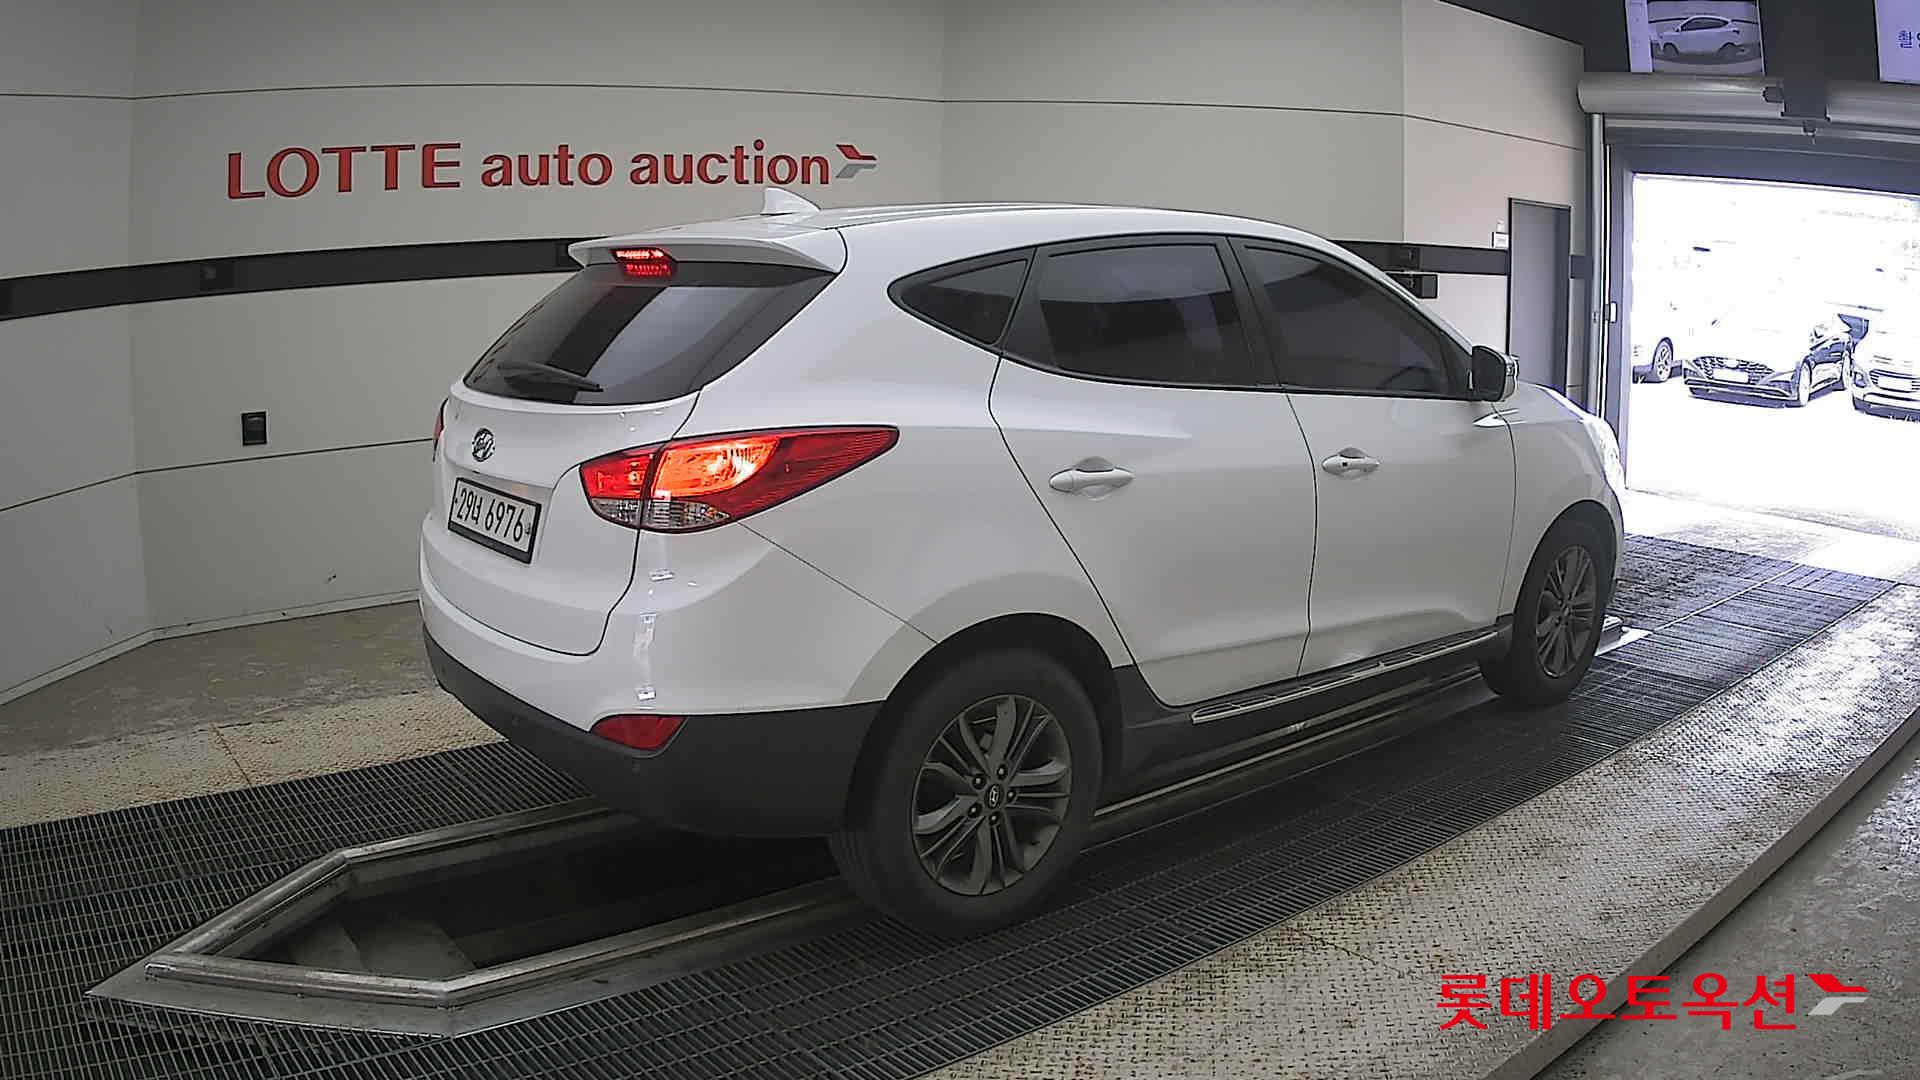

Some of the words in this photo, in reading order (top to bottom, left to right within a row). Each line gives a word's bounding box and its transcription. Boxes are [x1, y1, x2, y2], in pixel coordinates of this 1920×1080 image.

[1896, 30, 1920, 49] 촬
[227, 143, 461, 199] LOTTE
[480, 144, 613, 188] auto
[629, 139, 830, 186] auction
[457, 487, 483, 525] 29너
[485, 498, 524, 542] 6976
